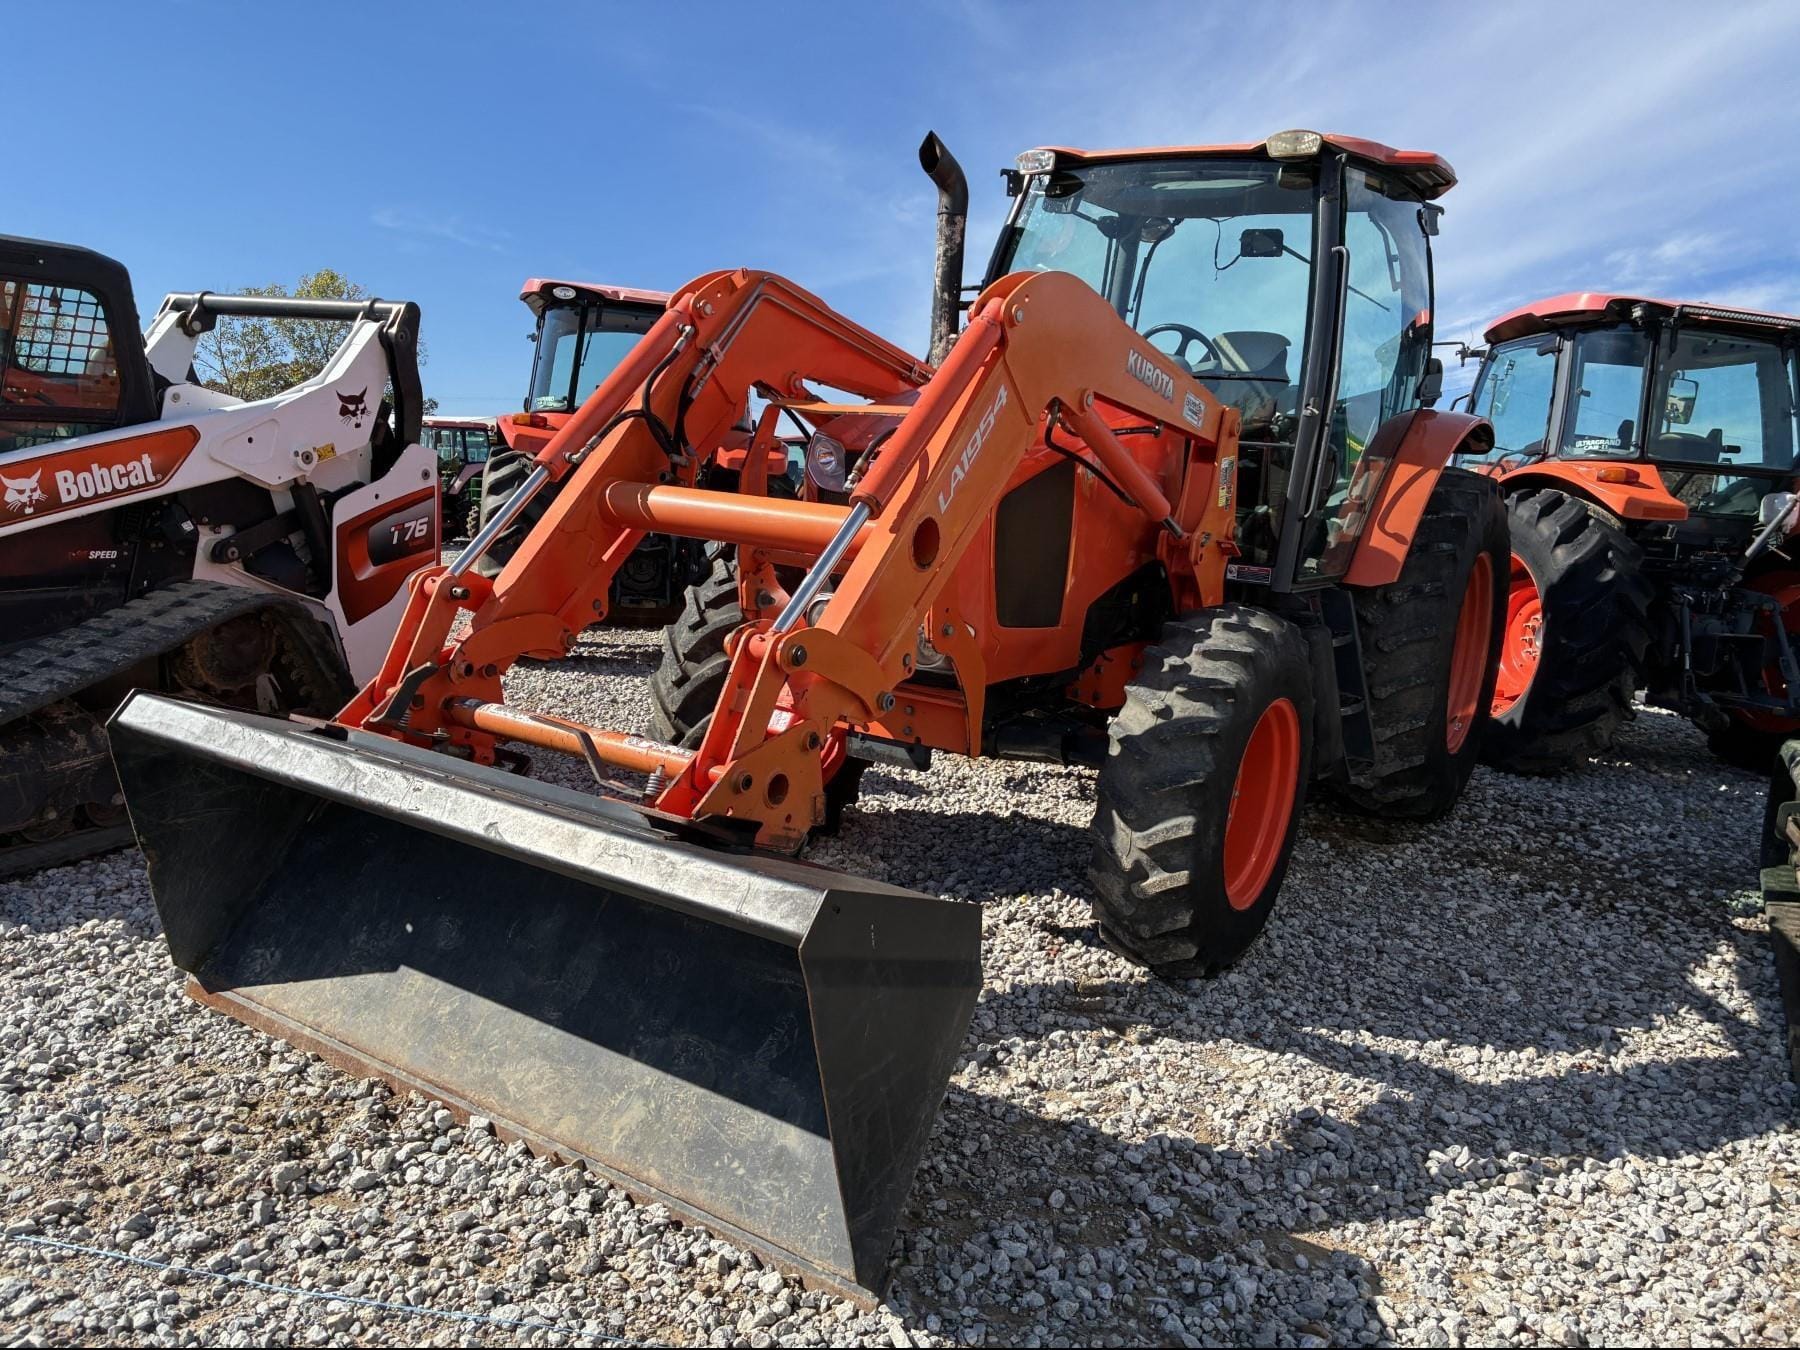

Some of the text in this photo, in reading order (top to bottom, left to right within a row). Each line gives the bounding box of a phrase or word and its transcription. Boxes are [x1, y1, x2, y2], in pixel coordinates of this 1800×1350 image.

[1127, 349, 1174, 401] KUBOTA
[938, 384, 1007, 515] LA1954
[55, 453, 156, 504] Bobcat
[88, 550, 117, 559] SPEED
[390, 516, 429, 545] T76
